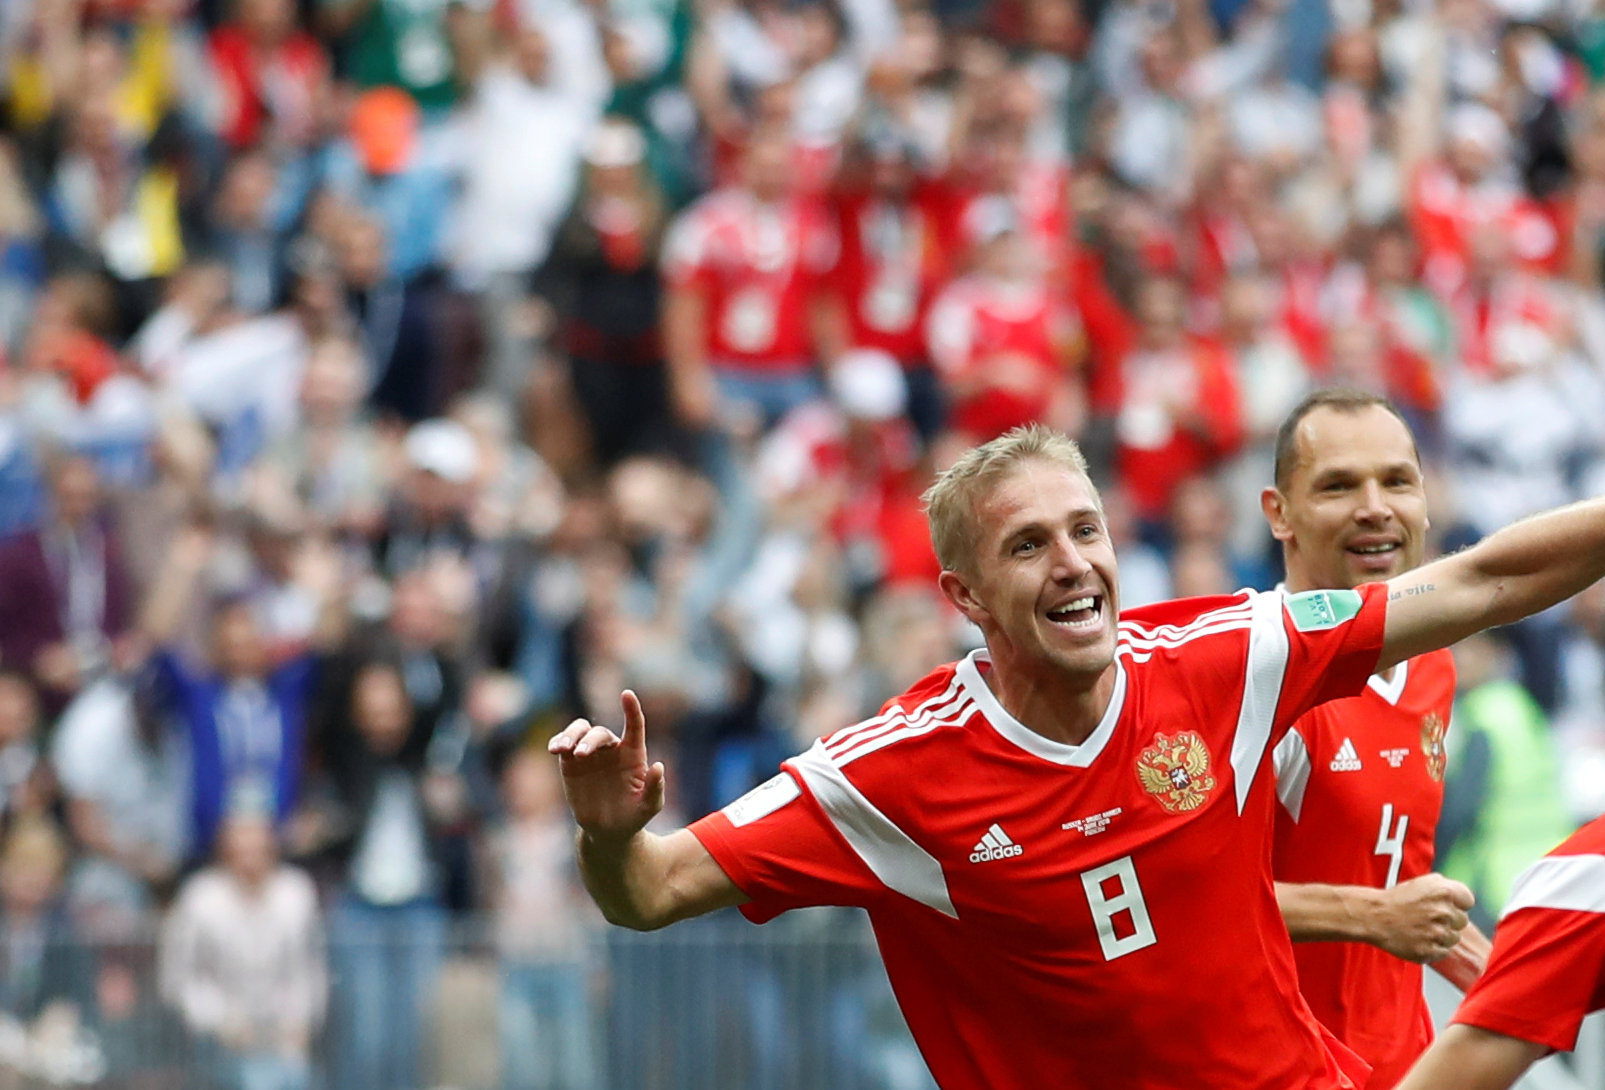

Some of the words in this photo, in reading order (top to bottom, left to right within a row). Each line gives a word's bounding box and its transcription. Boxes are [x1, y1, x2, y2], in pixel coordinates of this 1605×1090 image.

[968, 844, 1023, 863] adidas
[1374, 803, 1409, 890] 4
[1080, 855, 1158, 961] 8
